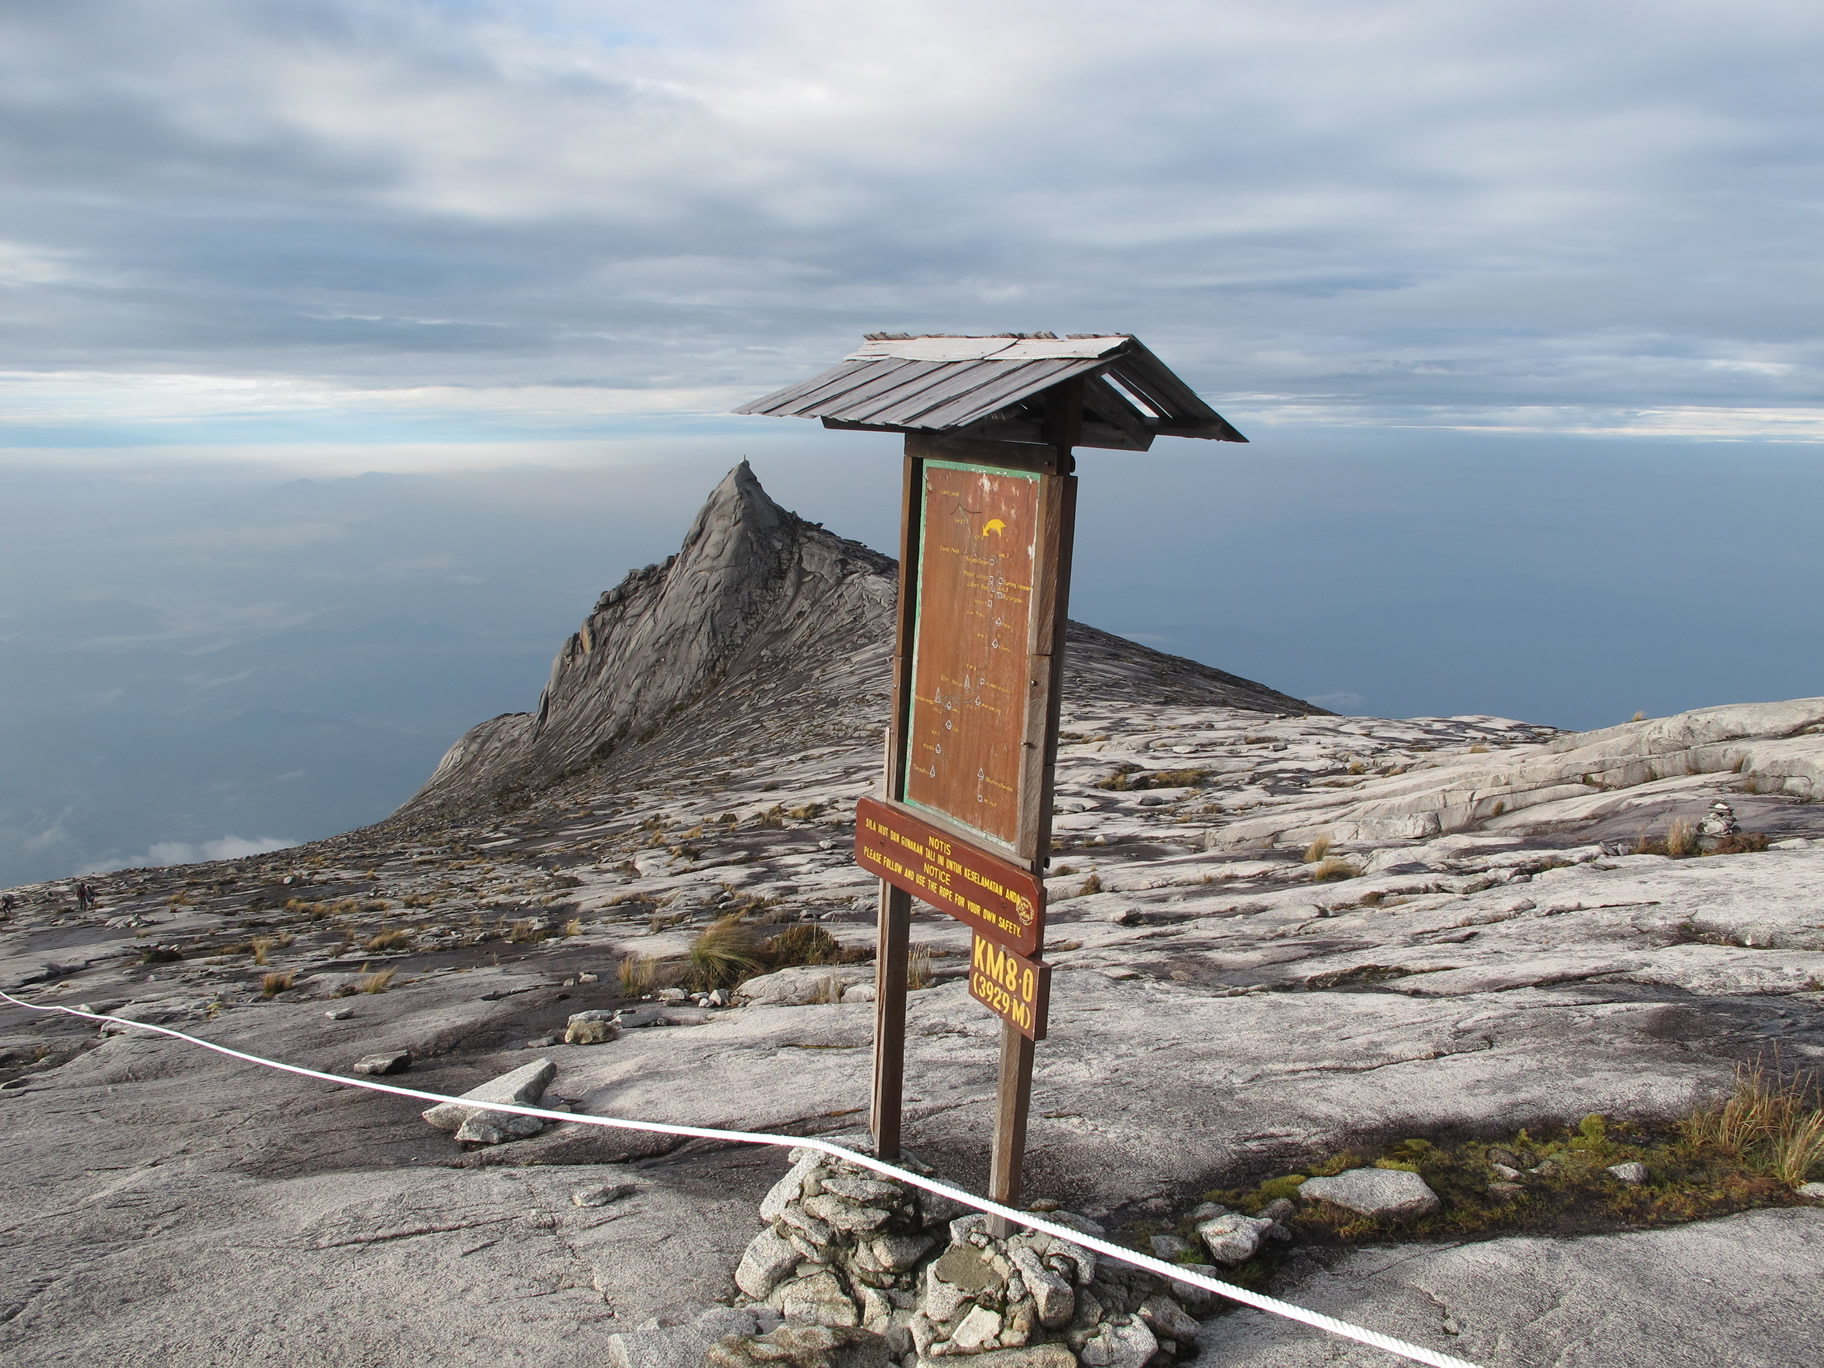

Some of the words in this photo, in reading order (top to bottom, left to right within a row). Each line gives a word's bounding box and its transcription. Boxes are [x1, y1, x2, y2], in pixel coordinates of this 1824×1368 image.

[865, 818, 876, 831] SILA
[890, 830, 900, 844] DAN
[901, 835, 924, 856] GUNAKAN
[925, 847, 936, 862] TALI
[946, 858, 963, 876] UNTUK
[964, 867, 1004, 896] KESELAMATAN
[1005, 889, 1022, 905] ANDA
[928, 835, 952, 856] NOTIS
[863, 845, 882, 865] PLEASE
[883, 855, 903, 875] FOLLOW
[904, 868, 915, 881] AND
[916, 873, 926, 887] USE
[927, 879, 938, 894] THE
[939, 886, 953, 902] ROPE
[954, 893, 966, 908] FOR
[967, 899, 981, 917] YOUR
[982, 908, 997, 925] OWN
[998, 916, 1022, 938] SAFETY.
[923, 862, 952, 886] NOTICE
